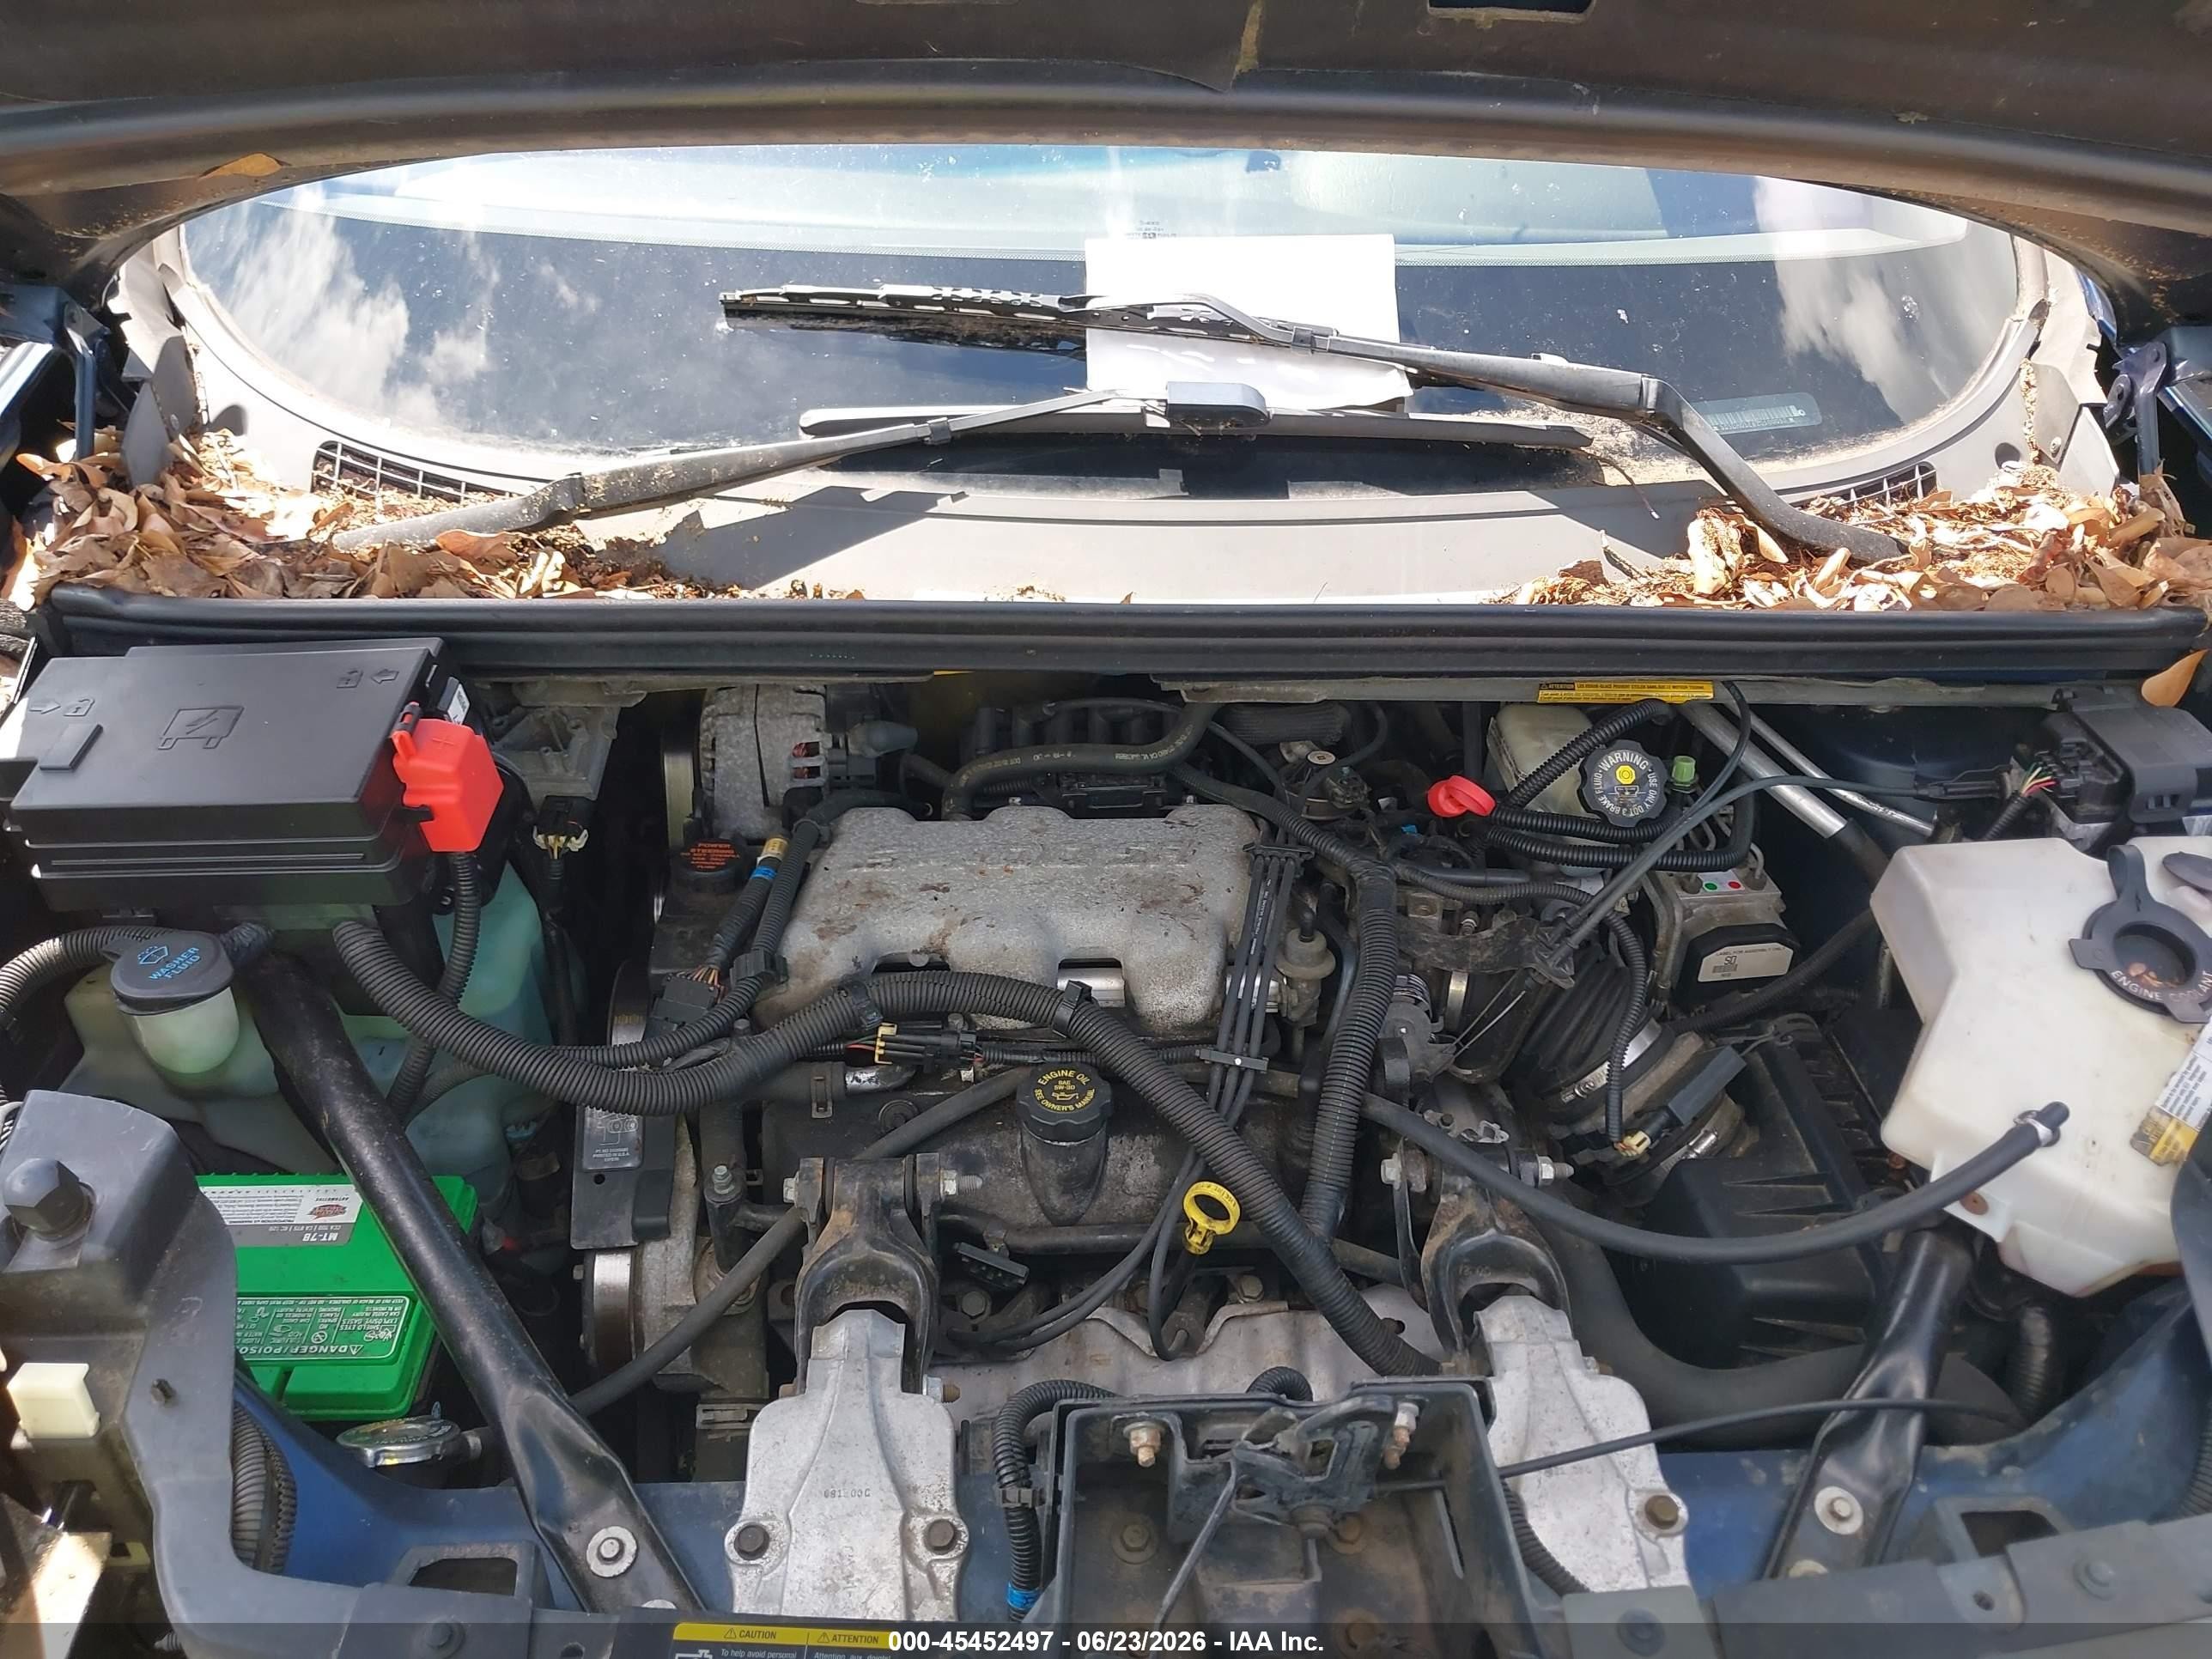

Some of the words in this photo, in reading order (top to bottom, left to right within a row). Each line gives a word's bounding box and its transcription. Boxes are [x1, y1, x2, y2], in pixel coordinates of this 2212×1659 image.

[1598, 751, 1649, 771] WARNING
[1593, 772, 1604, 794] FLUID
[1647, 772, 1658, 788] USE
[1598, 794, 1621, 815] BRAKE
[1643, 790, 1657, 810] ONLY
[1622, 808, 1628, 817] 3
[1630, 805, 1645, 817] DOT
[149, 947, 200, 981] WASHER
[163, 954, 202, 979] FLUID
[2111, 969, 2164, 1000] ENGINE
[1037, 1069, 1077, 1085] ENGINE
[1076, 1073, 1091, 1085] OIL
[1034, 1088, 1045, 1101] SEE
[1041, 1099, 1075, 1111] OWNER'S
[1075, 1088, 1096, 1109] MANUAL
[235, 1346, 348, 1354] DANGER/POISO
[738, 1630, 777, 1640] CAUTION
[830, 1634, 879, 1644] ATTENTION
[730, 1650, 745, 1658] help
[746, 1650, 766, 1658] avoid
